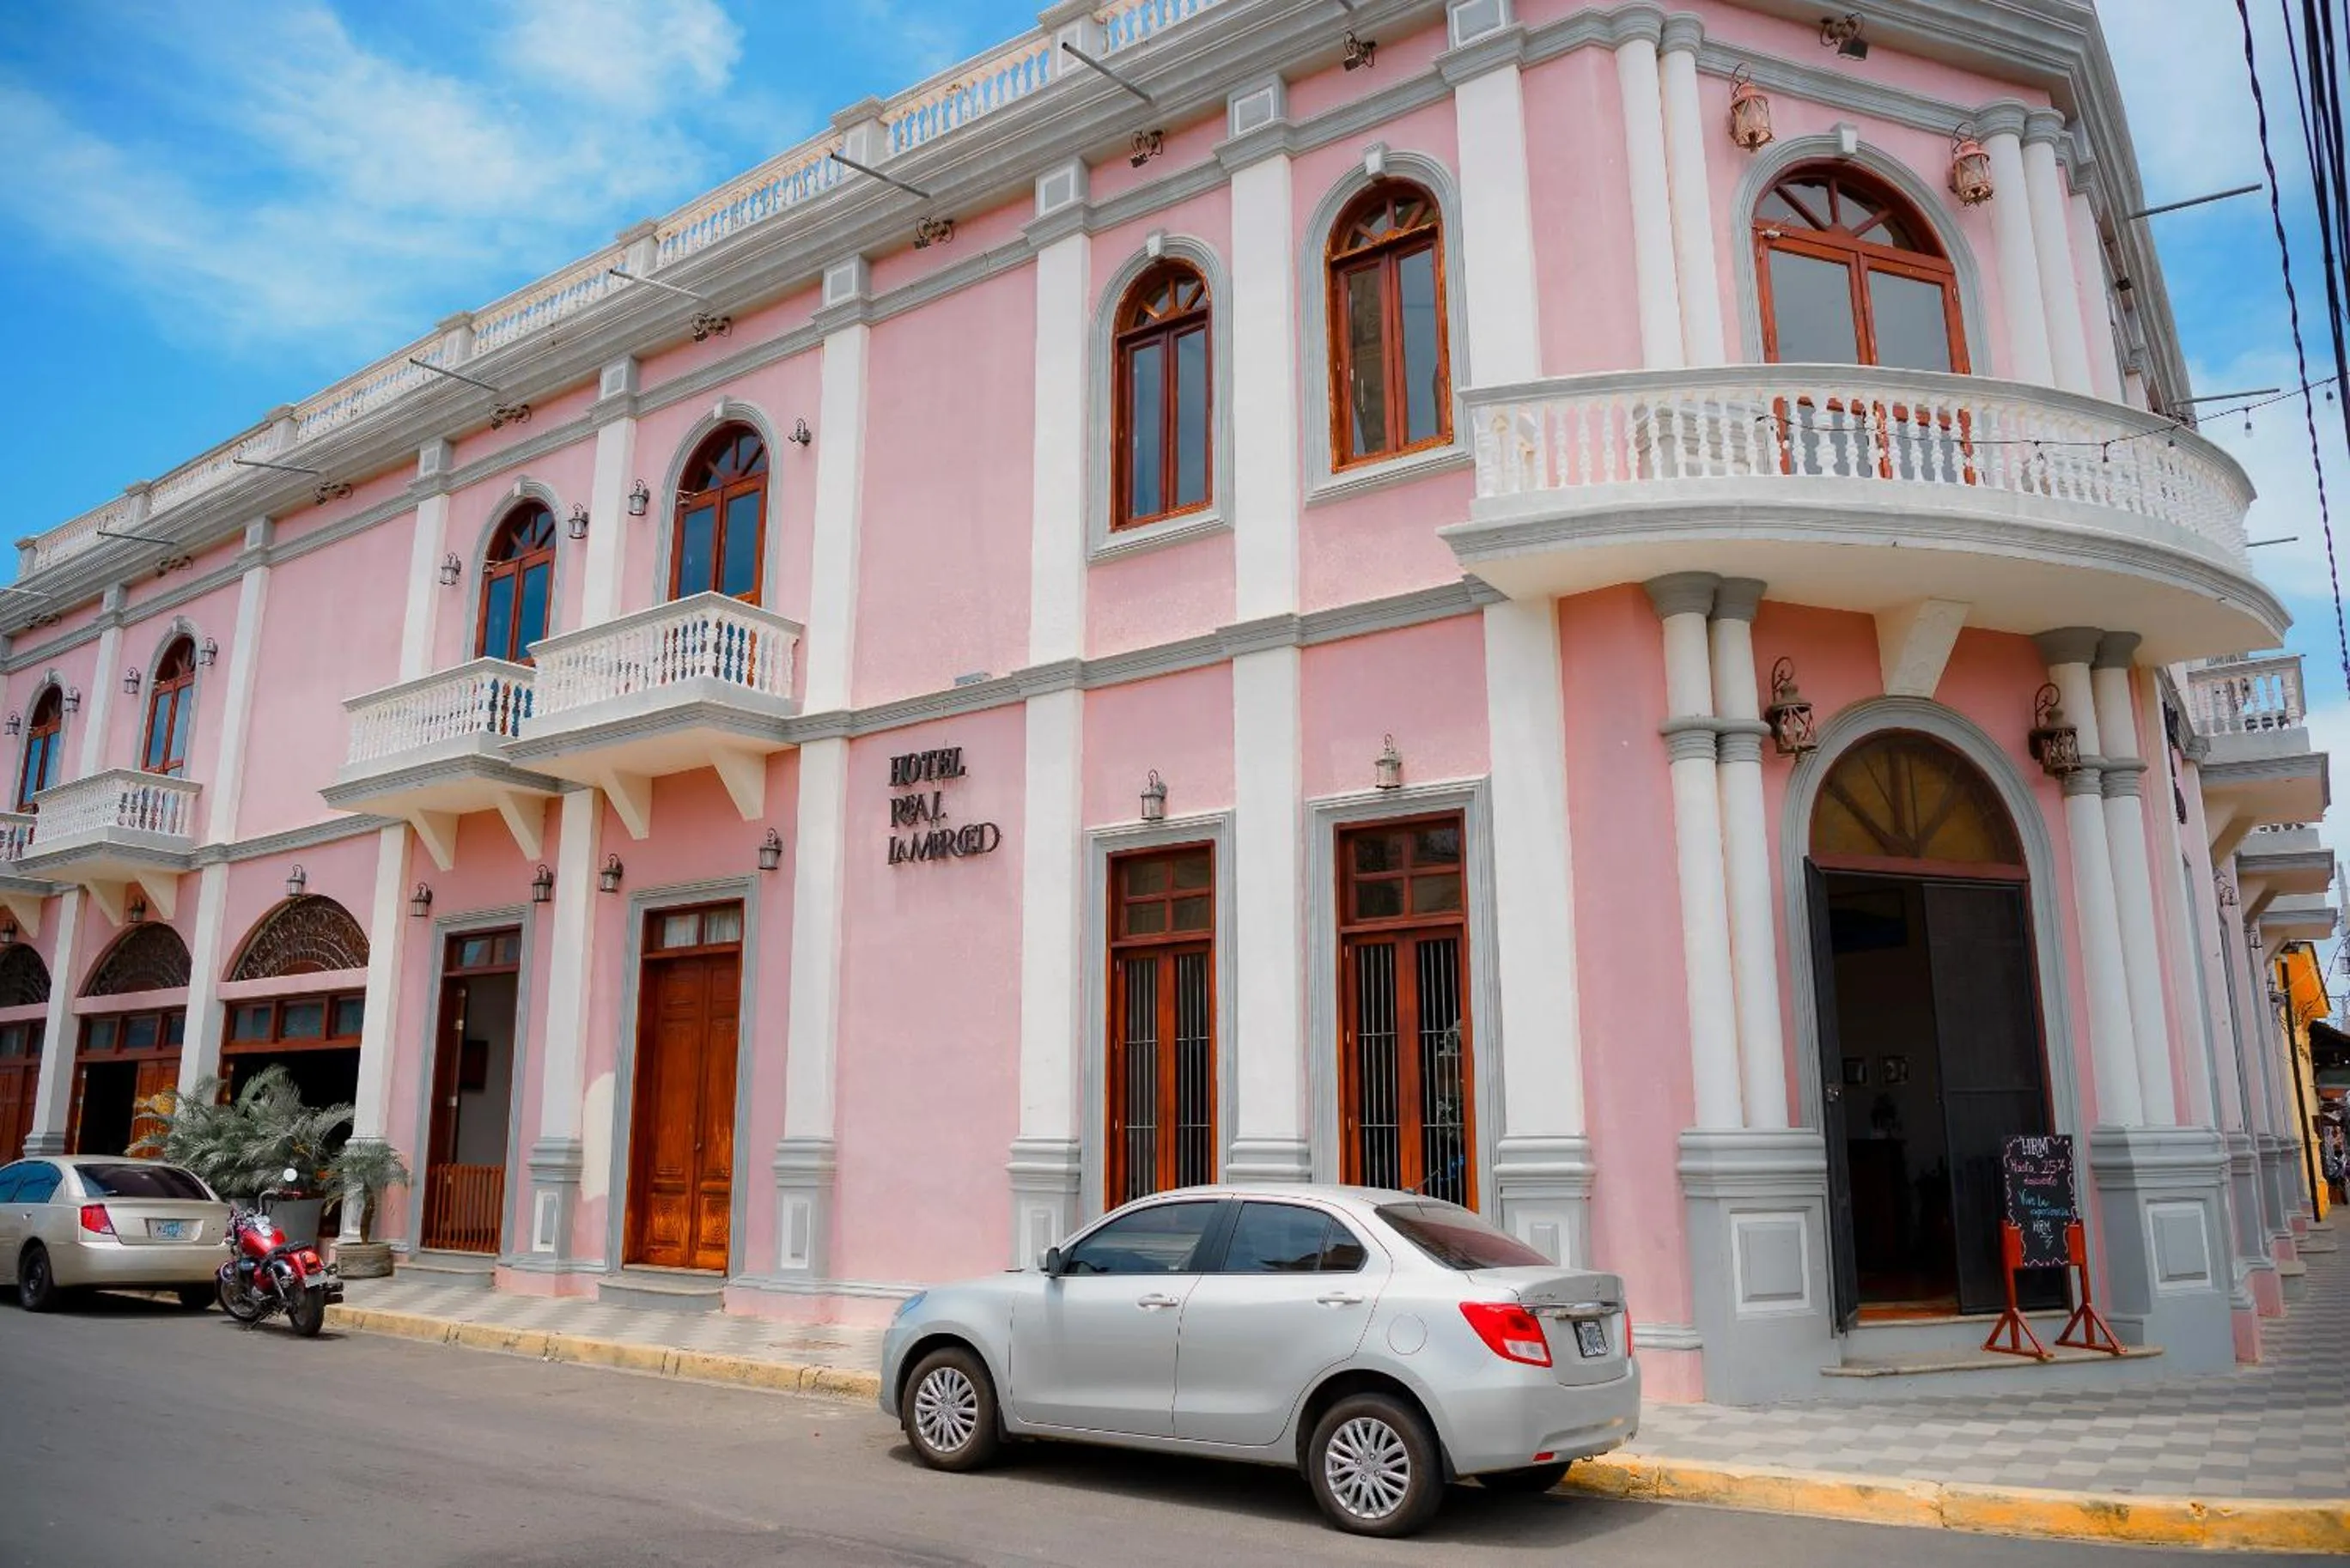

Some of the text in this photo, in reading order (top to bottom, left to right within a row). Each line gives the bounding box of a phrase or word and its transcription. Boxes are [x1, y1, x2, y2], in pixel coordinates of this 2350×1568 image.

[889, 746, 967, 787] HOTEL
[890, 791, 948, 828] REAL
[2021, 1136, 2049, 1158] HRM
